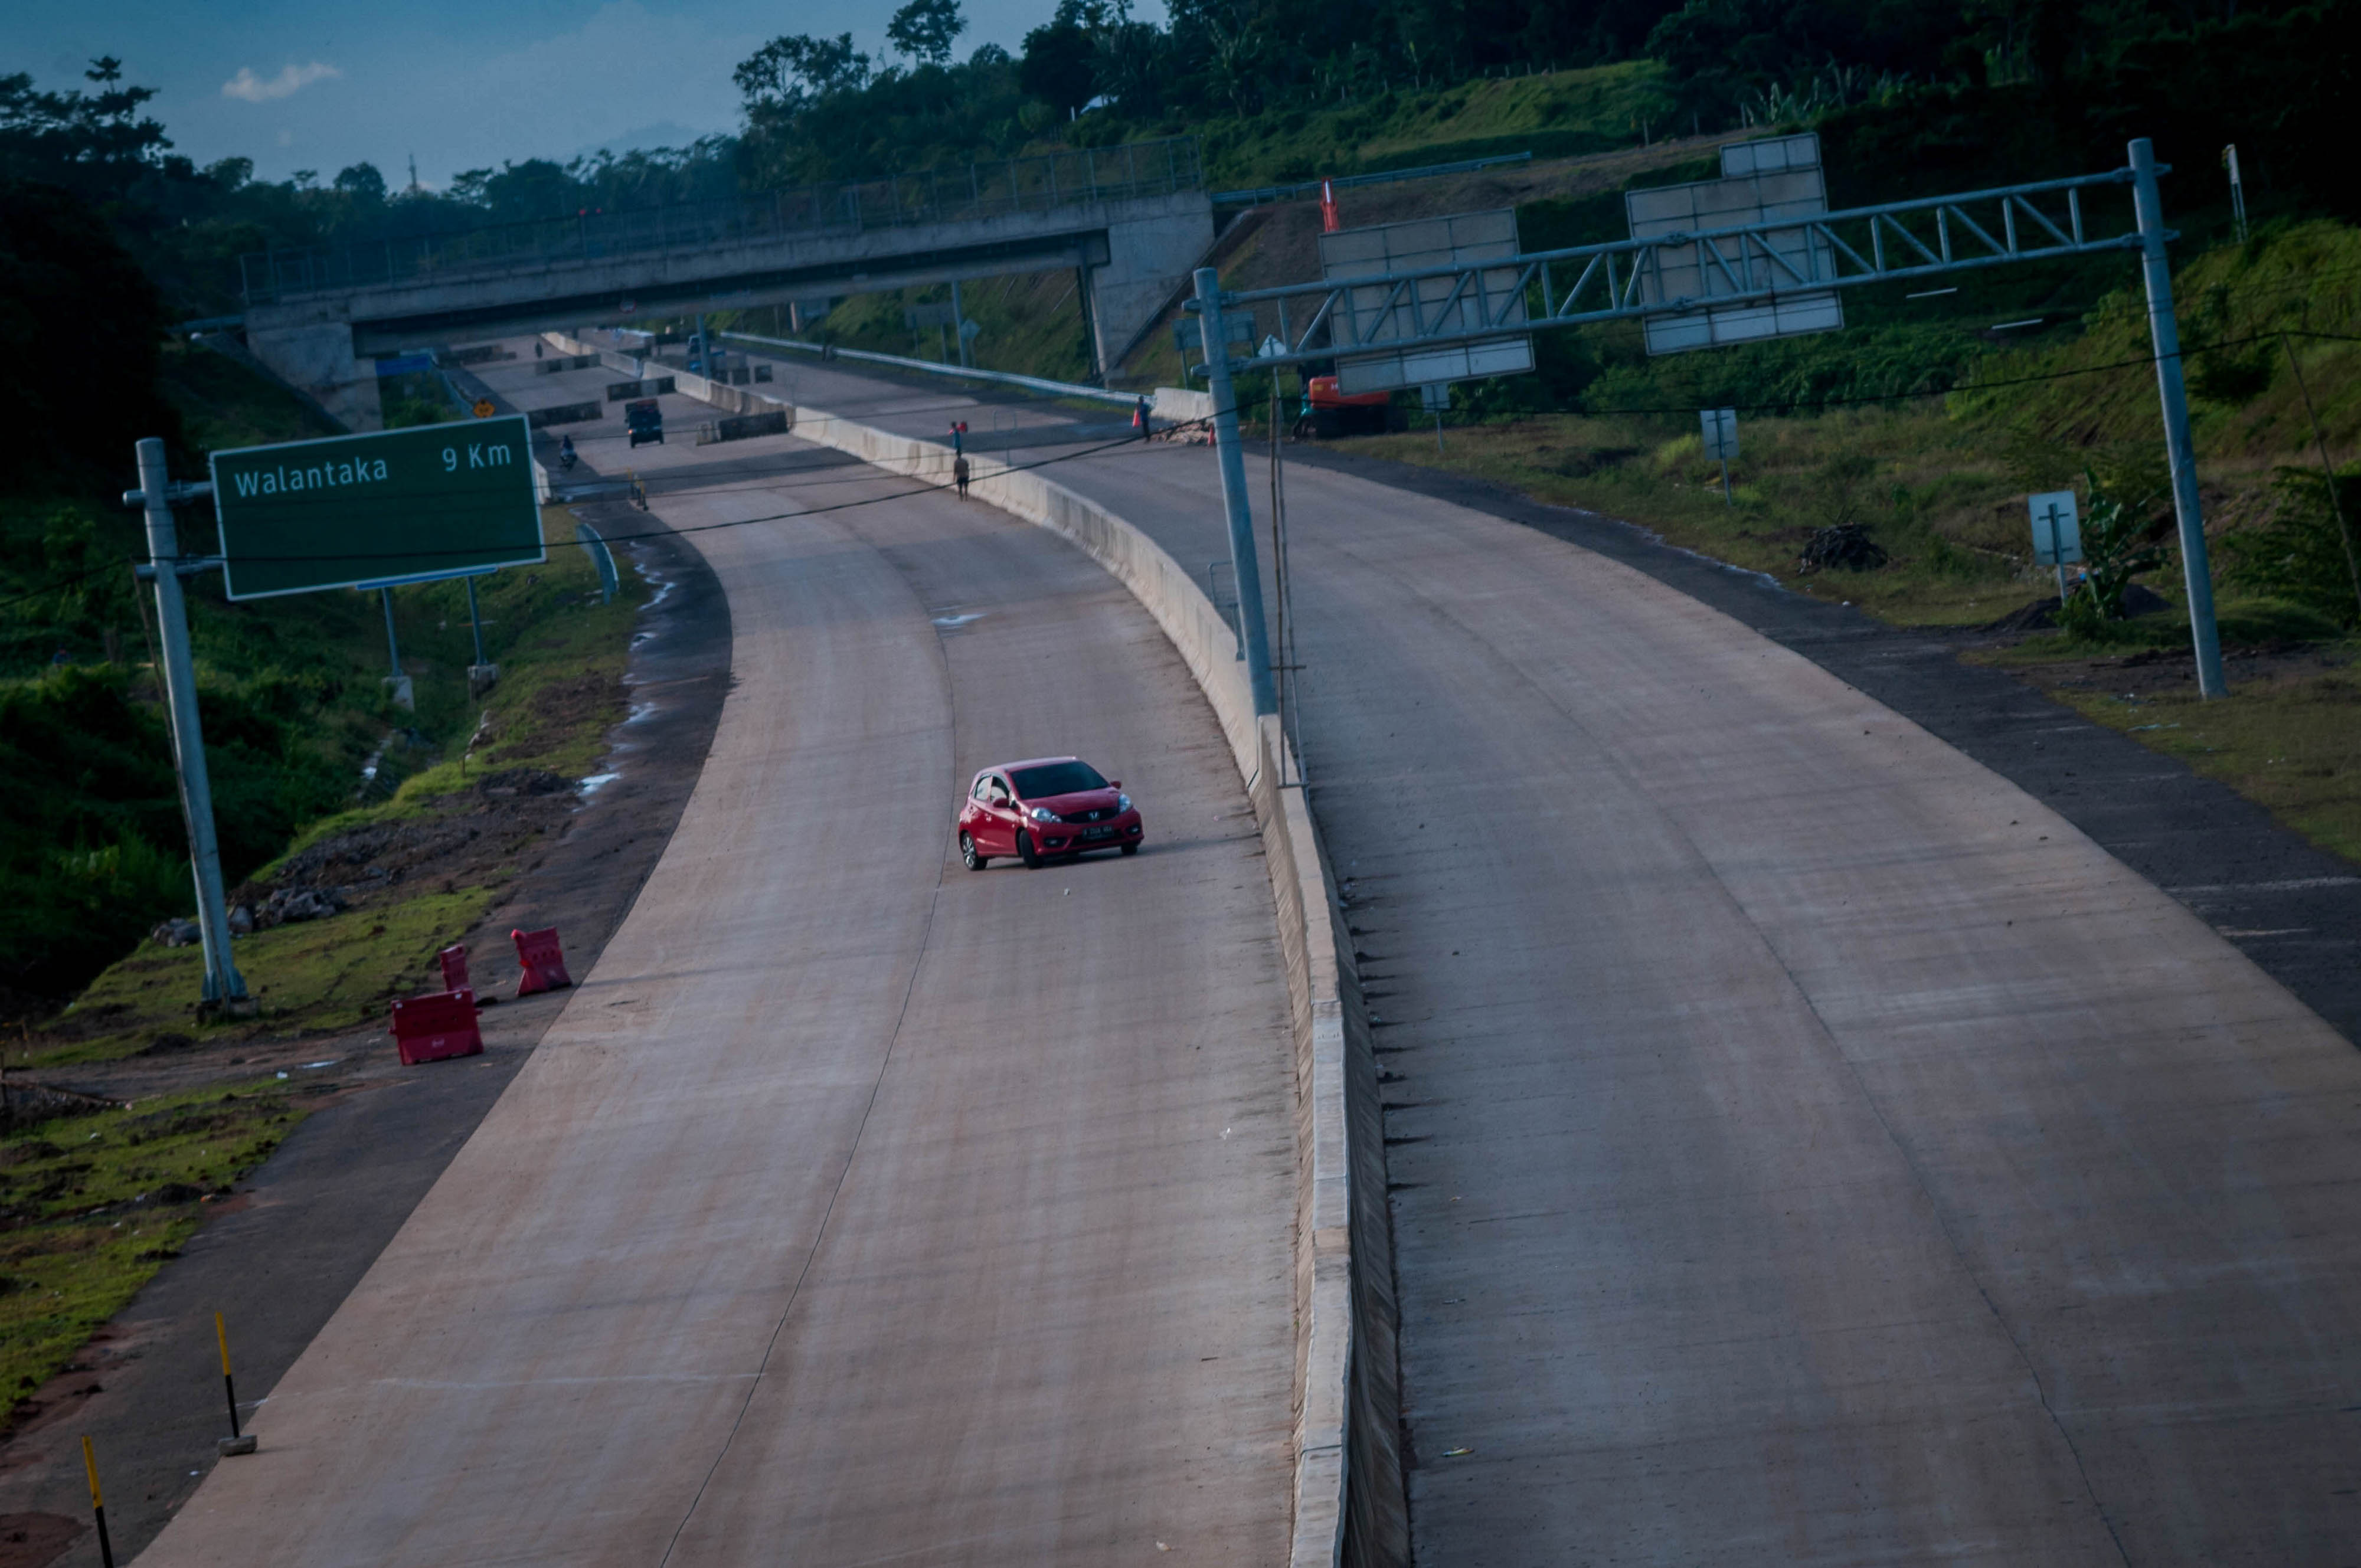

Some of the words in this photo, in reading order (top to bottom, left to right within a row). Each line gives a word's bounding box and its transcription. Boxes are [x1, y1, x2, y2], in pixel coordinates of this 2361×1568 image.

[235, 456, 388, 497] Walantaka
[442, 447, 457, 472] 9
[468, 443, 511, 469] Km
